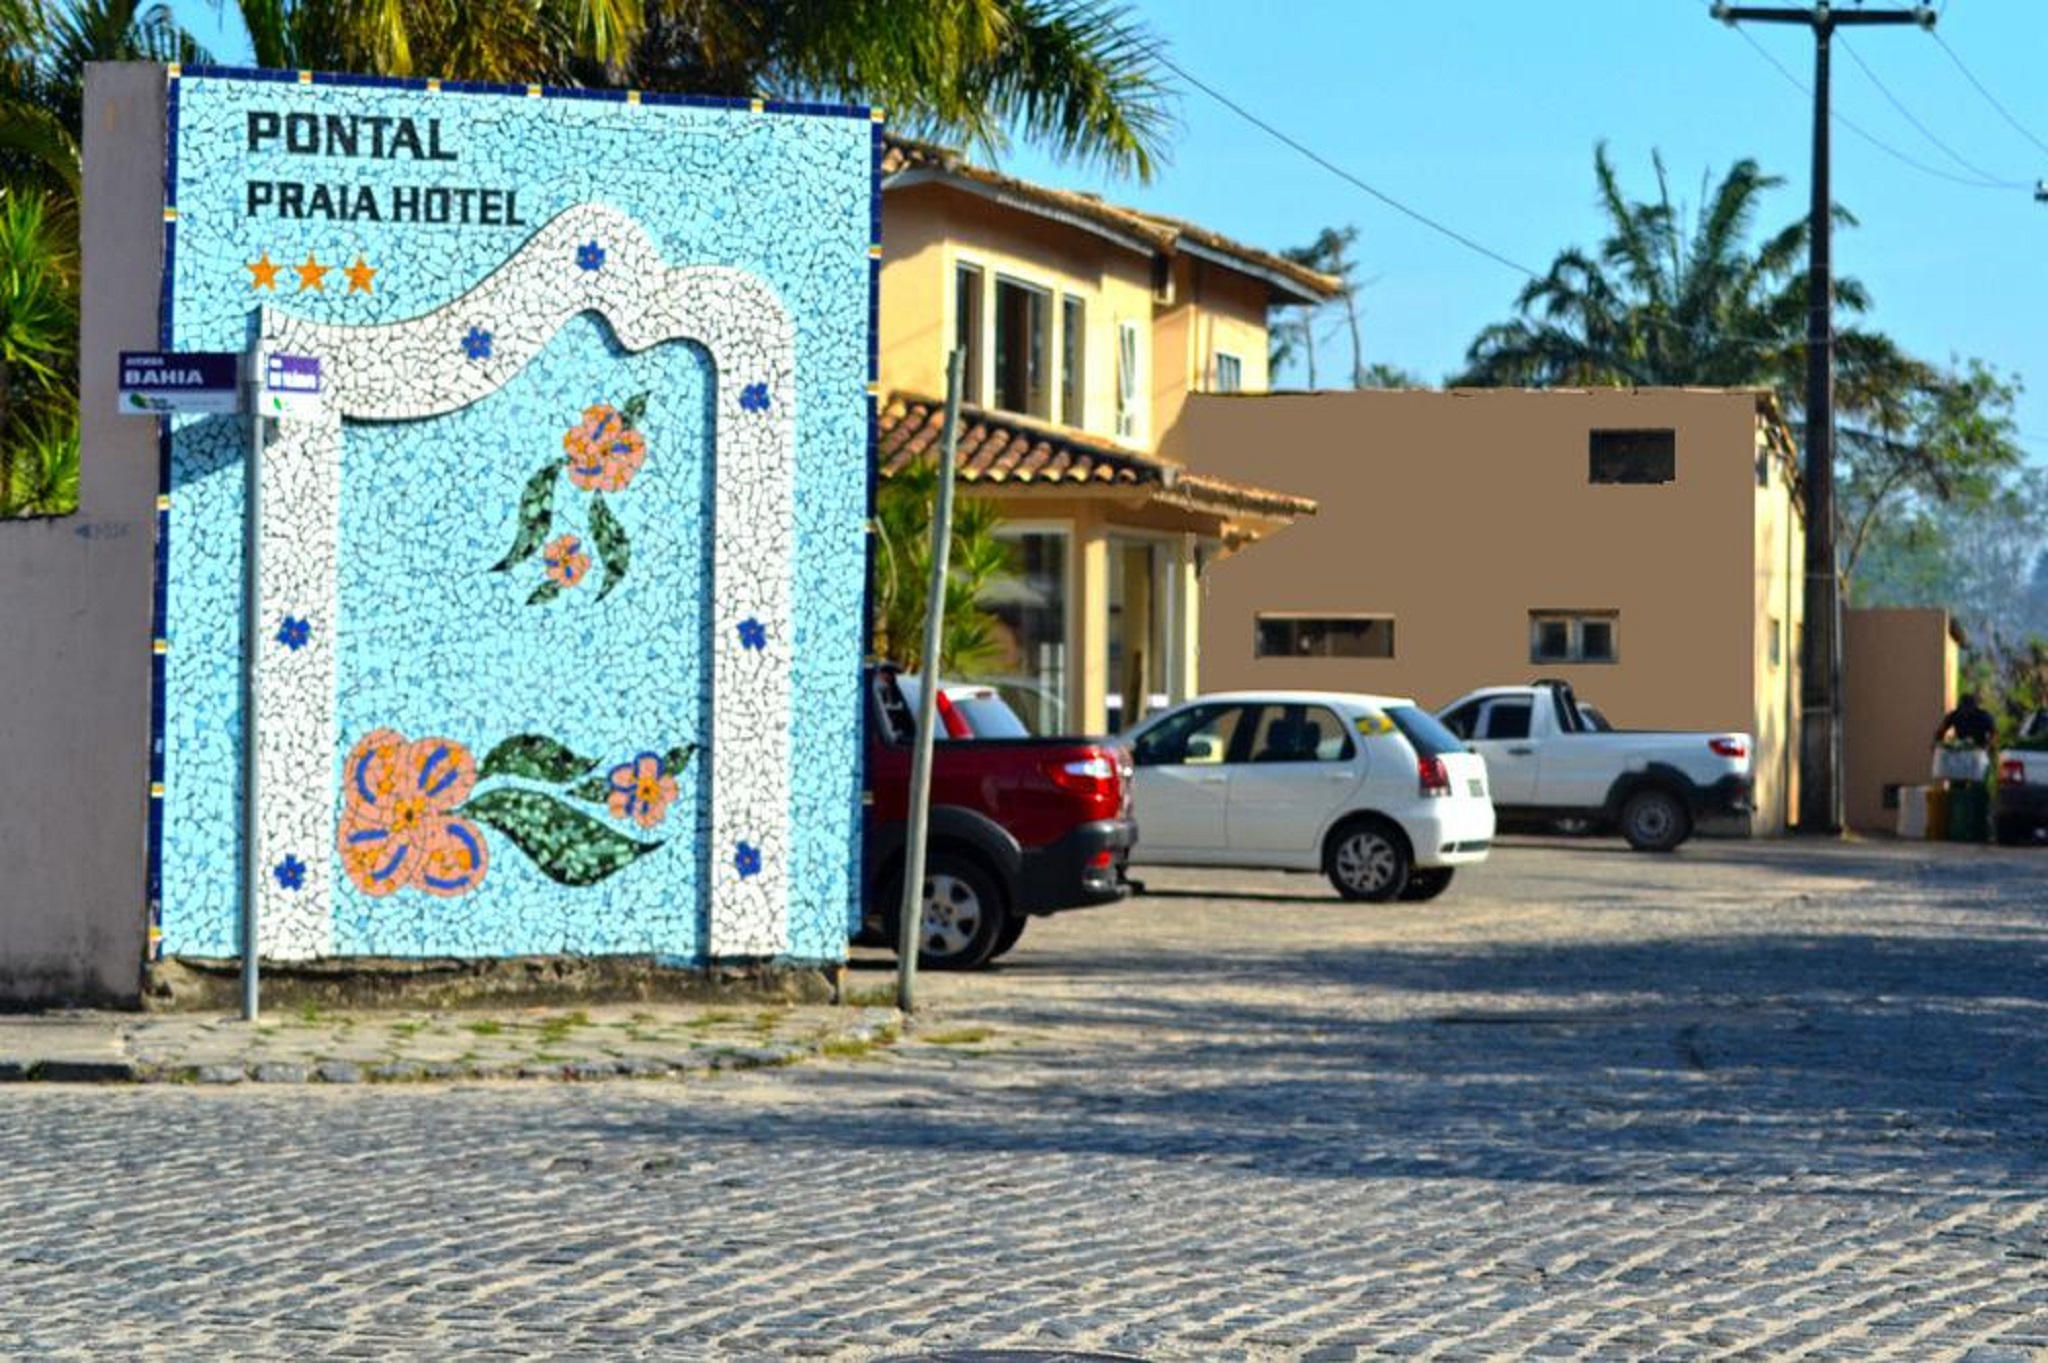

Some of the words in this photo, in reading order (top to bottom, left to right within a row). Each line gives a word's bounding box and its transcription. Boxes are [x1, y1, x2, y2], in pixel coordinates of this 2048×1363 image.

[247, 111, 458, 161] PONTAL
[247, 180, 382, 221] PRAIA
[392, 186, 526, 226] HOTEL
[125, 370, 203, 386] BAHIA
